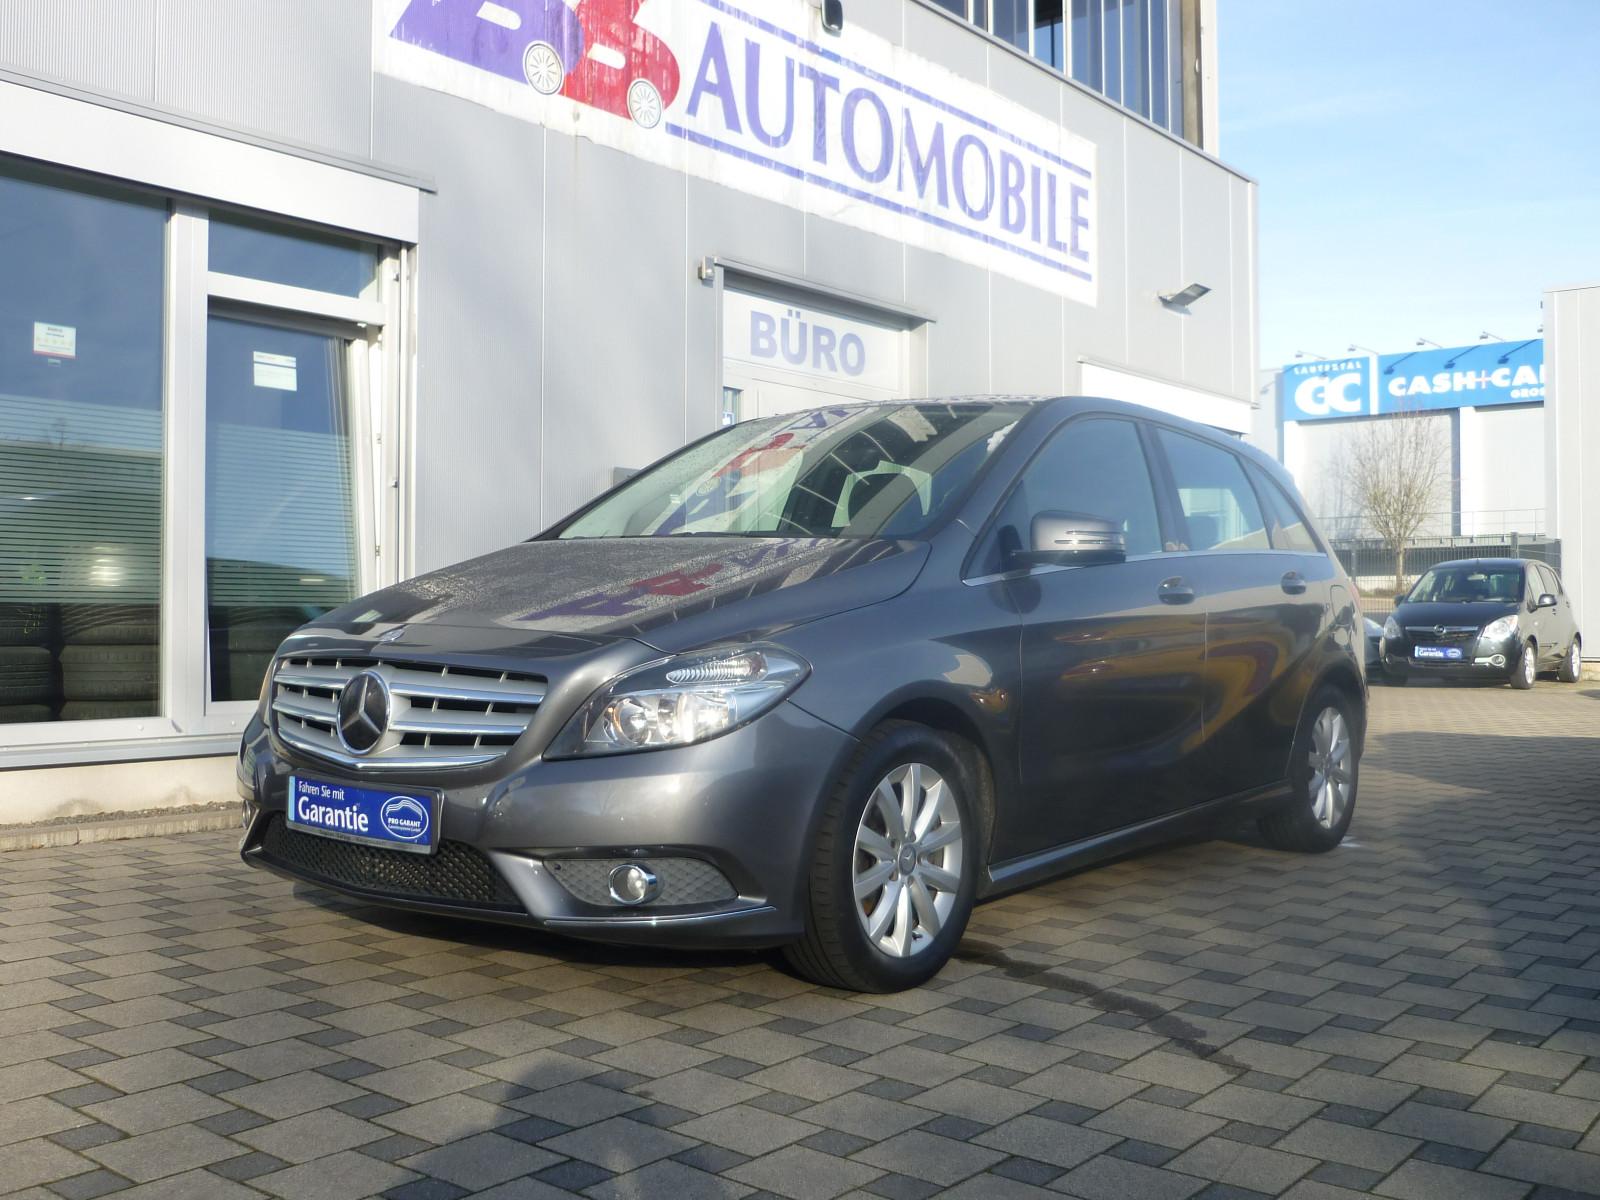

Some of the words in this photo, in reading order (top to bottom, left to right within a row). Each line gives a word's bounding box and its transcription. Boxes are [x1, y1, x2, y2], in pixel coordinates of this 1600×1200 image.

[687, 21, 1090, 262] AUTOMOBILE
[751, 309, 865, 376] BÜRO
[298, 781, 319, 795] Fahren
[321, 785, 331, 798] Sie
[332, 788, 345, 800] mit
[298, 796, 369, 832] Garantie
[387, 817, 399, 825] PRO
[400, 819, 421, 828] GARANT
